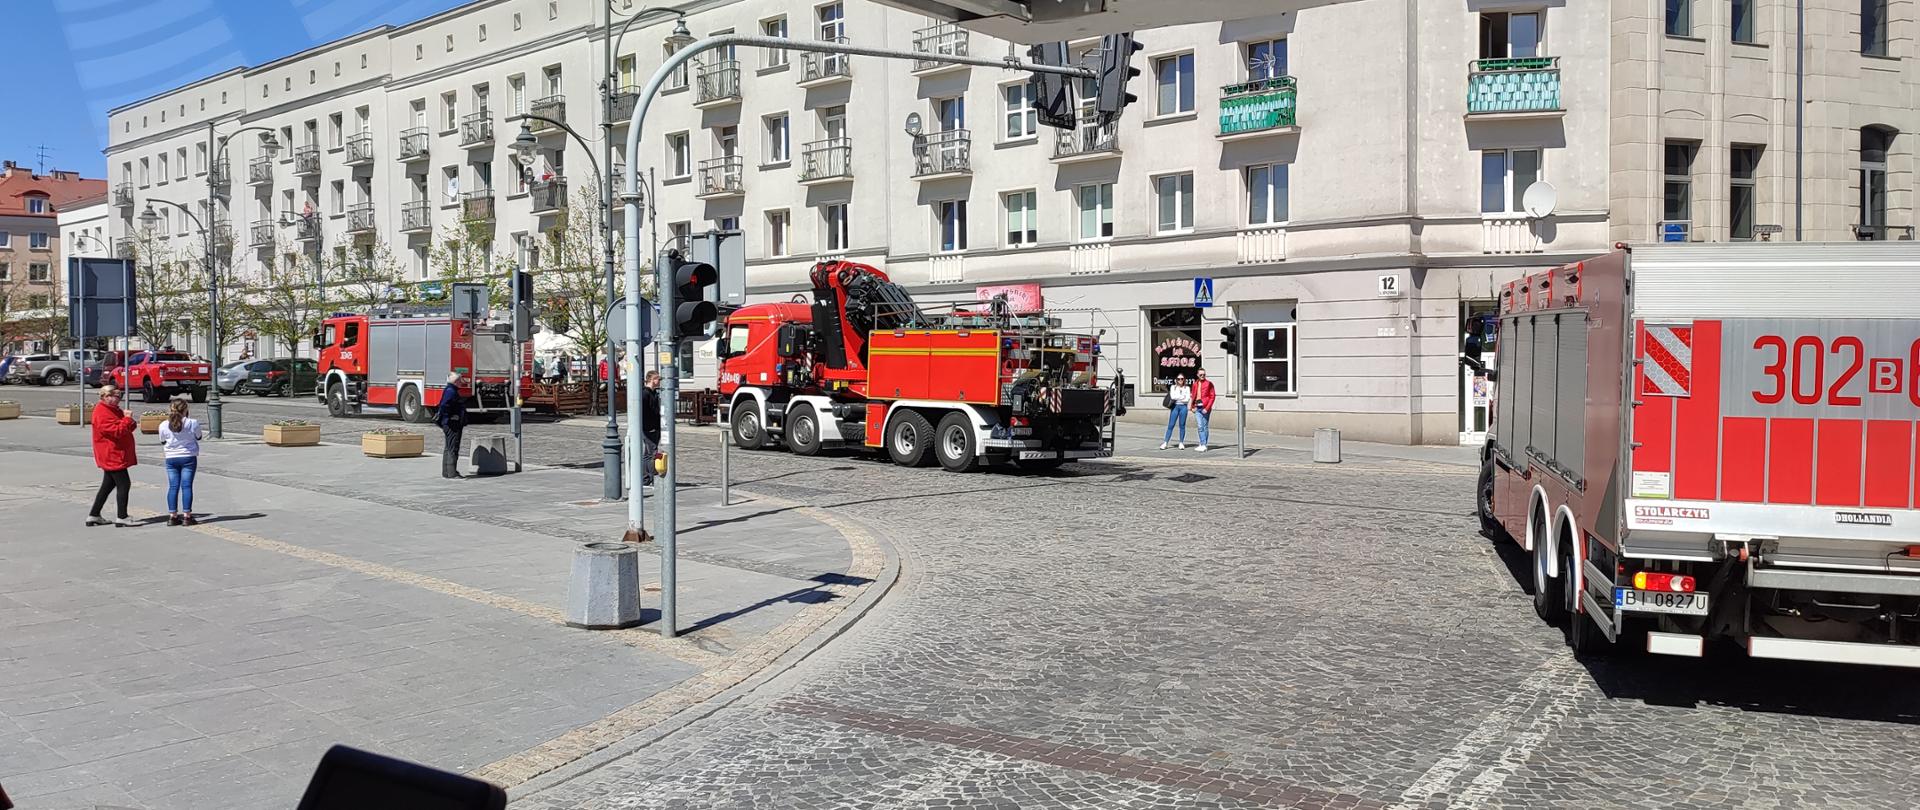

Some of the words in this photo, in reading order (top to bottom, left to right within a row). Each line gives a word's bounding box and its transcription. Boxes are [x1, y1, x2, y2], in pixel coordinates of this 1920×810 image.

[1381, 276, 1395, 290] 12
[1636, 506, 1709, 519] STOLARCZYK
[1835, 513, 1892, 525] DHOLLANDIA
[1626, 591, 1645, 606] BI
[1655, 593, 1706, 610] 0827U
